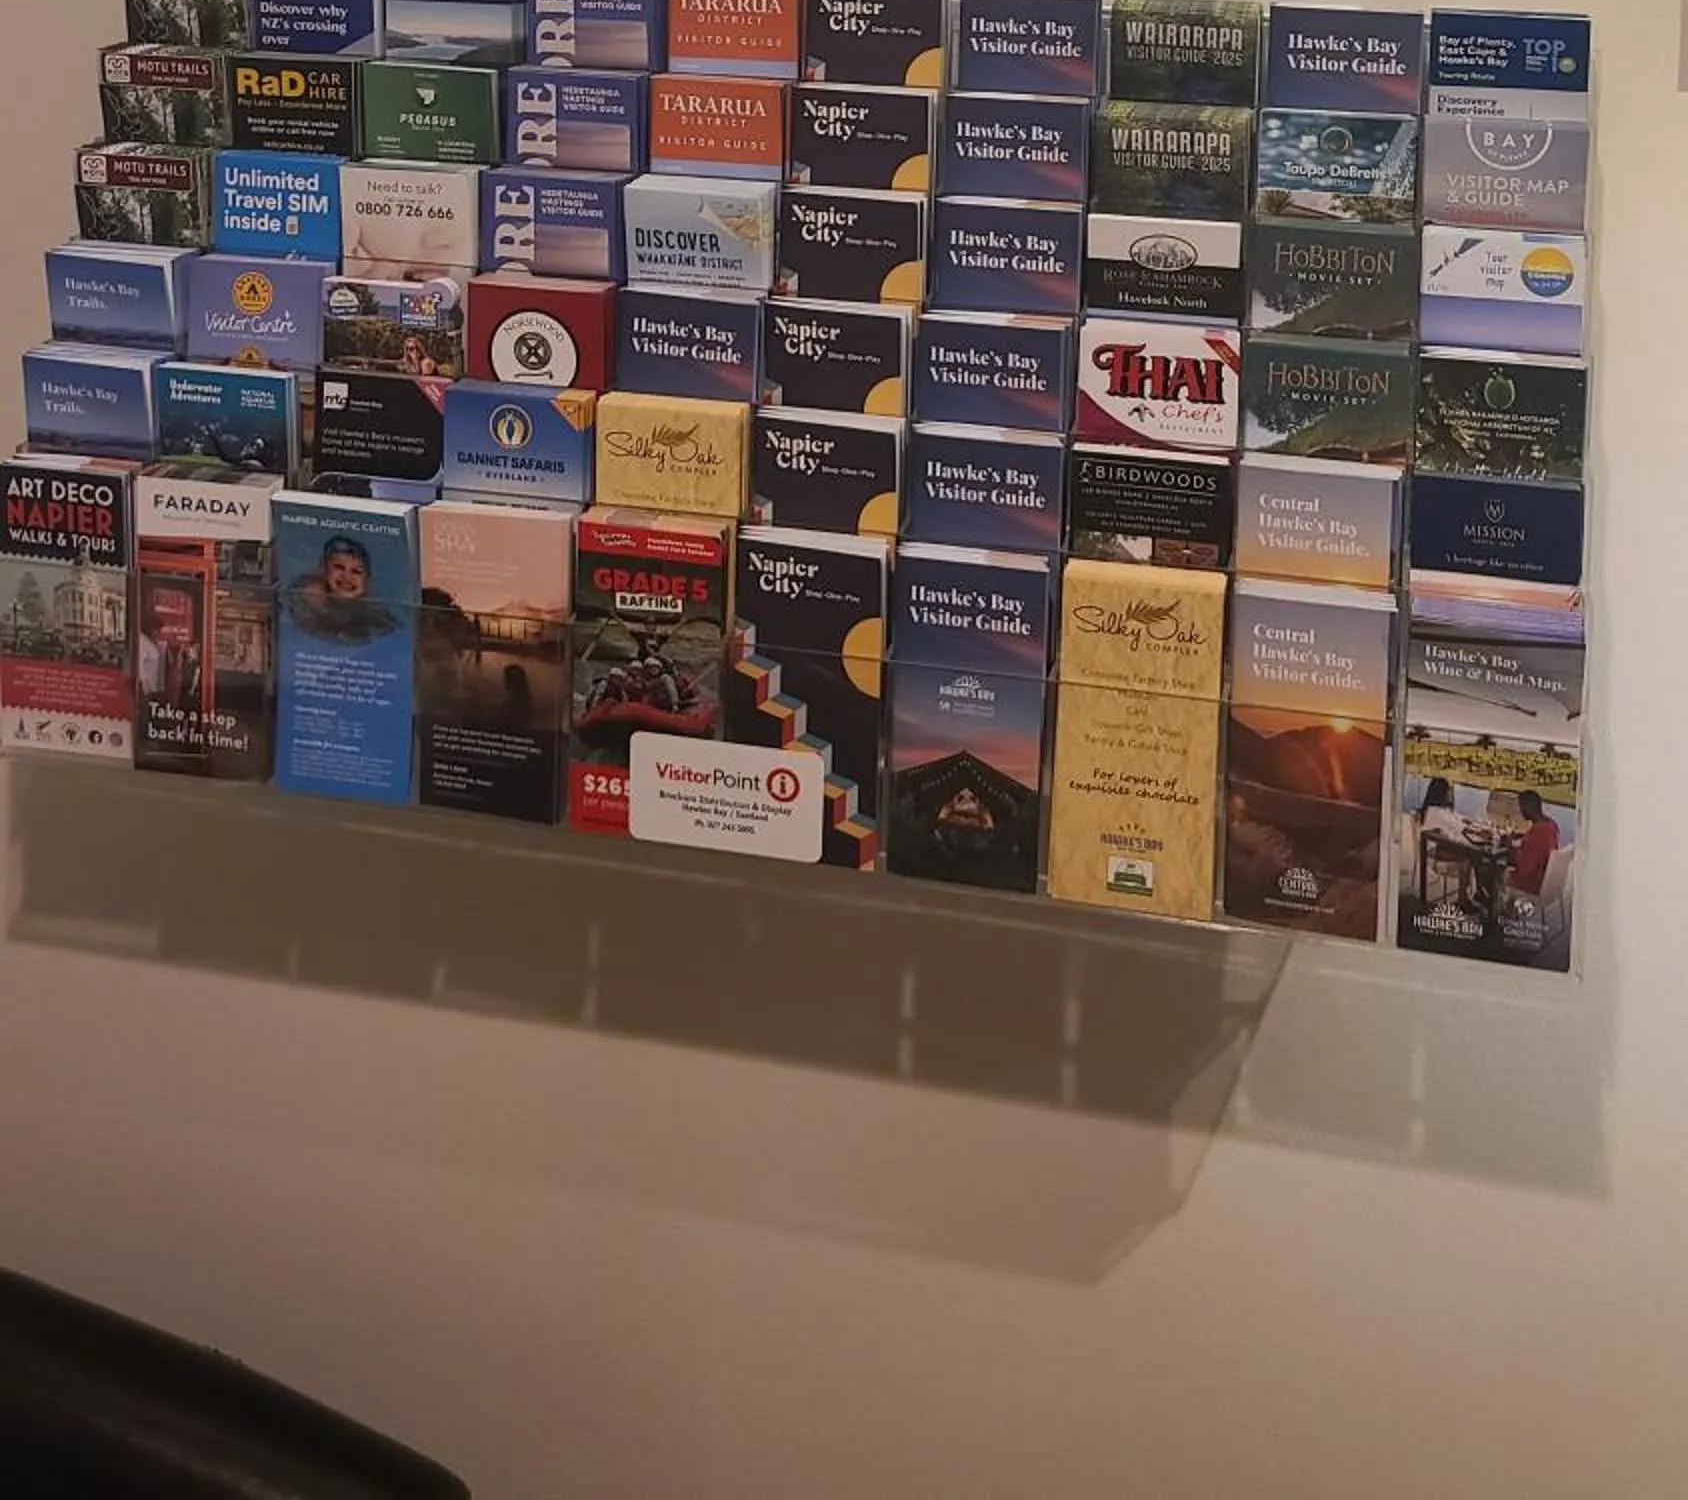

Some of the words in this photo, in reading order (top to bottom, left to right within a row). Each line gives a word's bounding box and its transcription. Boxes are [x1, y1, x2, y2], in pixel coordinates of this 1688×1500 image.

[260, 1, 314, 15] Discover
[319, 5, 348, 19] why
[698, 14, 763, 24] DISTRICT
[261, 18, 290, 30] NZ's
[293, 21, 348, 35] crossing
[830, 14, 870, 36] City
[970, 17, 1042, 36] Hawke's
[1045, 20, 1077, 38] Bay
[1126, 21, 1243, 50] WAIRARAPA
[262, 35, 290, 45] over
[677, 35, 732, 46] VISITOR
[740, 38, 783, 47] GUIDE
[970, 37, 1028, 54] Visitor
[1031, 39, 1082, 58] Guide
[1288, 33, 1363, 52] Hawke's
[1367, 37, 1401, 57] Bay
[1523, 39, 1566, 55] TOP
[138, 61, 169, 73] MOTU
[170, 63, 209, 75] TRAILS
[1126, 48, 1172, 62] VISITOR
[1173, 51, 1206, 63] GUIDE
[1213, 51, 1243, 65] 2025
[1287, 53, 1348, 73] Visitor
[1351, 57, 1407, 75] Guide
[236, 68, 305, 97] RaD
[307, 72, 341, 84] CAR
[309, 87, 347, 100] HIRE
[660, 92, 766, 117] TARARUA
[1437, 94, 1498, 106] Discovery
[399, 113, 457, 127] PEGASUS
[681, 116, 748, 128] DISTRICT
[1437, 105, 1504, 116] Experience
[660, 136, 715, 148] VISITOR
[724, 140, 766, 150] GUIDE
[1112, 128, 1230, 156] WAIRARAPA
[1484, 132, 1535, 148] BAY
[114, 161, 144, 174] MOTU
[149, 163, 187, 177] TRAILS
[1113, 153, 1159, 169] VISITOR
[1161, 156, 1194, 170] GUIDE
[1201, 157, 1231, 172] 2025
[225, 168, 319, 191] Unlimited
[367, 180, 399, 193] Need
[401, 183, 412, 194] to
[414, 183, 442, 195] talk?
[1446, 172, 1521, 191] VISITOR
[1527, 179, 1569, 194] MAP
[224, 191, 282, 209] Travel
[287, 194, 328, 214] SIM
[1465, 191, 1524, 206] GUIDE
[224, 210, 281, 233] inside
[356, 201, 391, 215] 0800
[397, 204, 423, 217] 726
[427, 205, 454, 220] 666
[792, 204, 858, 227] Napier
[635, 228, 720, 252] DISCOVER
[801, 224, 844, 247] City
[950, 229, 1021, 249] Hawke's
[1026, 235, 1059, 254] Bay
[701, 256, 743, 271] DISTRICT
[950, 250, 1008, 269] Visitor
[1012, 255, 1065, 273] Guide
[65, 277, 116, 294] Hawke's
[117, 284, 140, 299] Bay
[1298, 272, 1341, 283] MOVIE
[1349, 276, 1375, 286] SET
[1174, 295, 1207, 308] North
[205, 309, 248, 331] Visitor
[251, 310, 297, 334] Centre
[633, 317, 700, 339] Hawke's
[705, 326, 737, 345] Bay
[632, 337, 688, 357] Visitor
[691, 344, 742, 364] Guide
[1092, 343, 1225, 404] THAI
[42, 381, 93, 398] Hawke's
[96, 388, 118, 403] Bay
[1291, 391, 1336, 404] MOVIE
[1343, 395, 1368, 405] SET
[1162, 404, 1223, 423] Chef's
[605, 431, 666, 474] Silky
[669, 436, 726, 466] Oak
[766, 430, 835, 453] Napier
[458, 452, 508, 469] GANNET
[511, 456, 565, 473] SAFARIS
[776, 452, 820, 475] City
[926, 461, 1000, 483] Hawke's
[1006, 467, 1039, 487] Bay
[1096, 466, 1216, 491] BIRDWOODS
[8, 477, 44, 499] ART
[51, 481, 113, 507] DECO
[926, 481, 987, 502] Visitor
[991, 487, 1047, 509] Guide
[1260, 494, 1319, 513] Central
[154, 494, 250, 517] FARADAY
[7, 501, 113, 536] NAPIER
[1259, 513, 1326, 533] Hawke's
[1330, 519, 1358, 537] Bay
[9, 528, 52, 545] WALKS
[56, 532, 67, 545] &
[72, 535, 115, 552] TOURS
[1257, 532, 1313, 549] Visitor
[1464, 525, 1525, 540] MISSION
[749, 552, 819, 578] Napier
[593, 568, 687, 597] GRADE
[692, 579, 708, 600] 5
[759, 573, 804, 599] City
[620, 595, 678, 609] RAFTING
[910, 585, 987, 609] Hawke's
[991, 592, 1025, 614] Bay
[909, 606, 972, 629] Visitor
[975, 614, 1032, 636] Guide
[1073, 605, 1142, 651] Silky
[1145, 611, 1207, 645] Oak
[1254, 623, 1316, 645] Central
[1253, 644, 1322, 664] Hawke's
[1325, 651, 1357, 671] Bay
[1425, 644, 1488, 663] Hawke's
[1491, 654, 1521, 671] Bay
[1252, 663, 1308, 681] Visitor
[1424, 661, 1463, 677] Wine
[1485, 670, 1524, 685] Food
[1526, 675, 1567, 692] Map.
[150, 702, 184, 720] Take
[189, 709, 198, 722] a
[203, 709, 237, 728] step
[148, 724, 185, 742] back
[189, 729, 203, 744] in
[207, 731, 249, 751] time!
[656, 762, 760, 791] VisitorPoint
[1094, 768, 1114, 778] For
[1164, 777, 1178, 791] of
[1069, 780, 1130, 795] exquisite
[1136, 789, 1199, 805] chocolate
